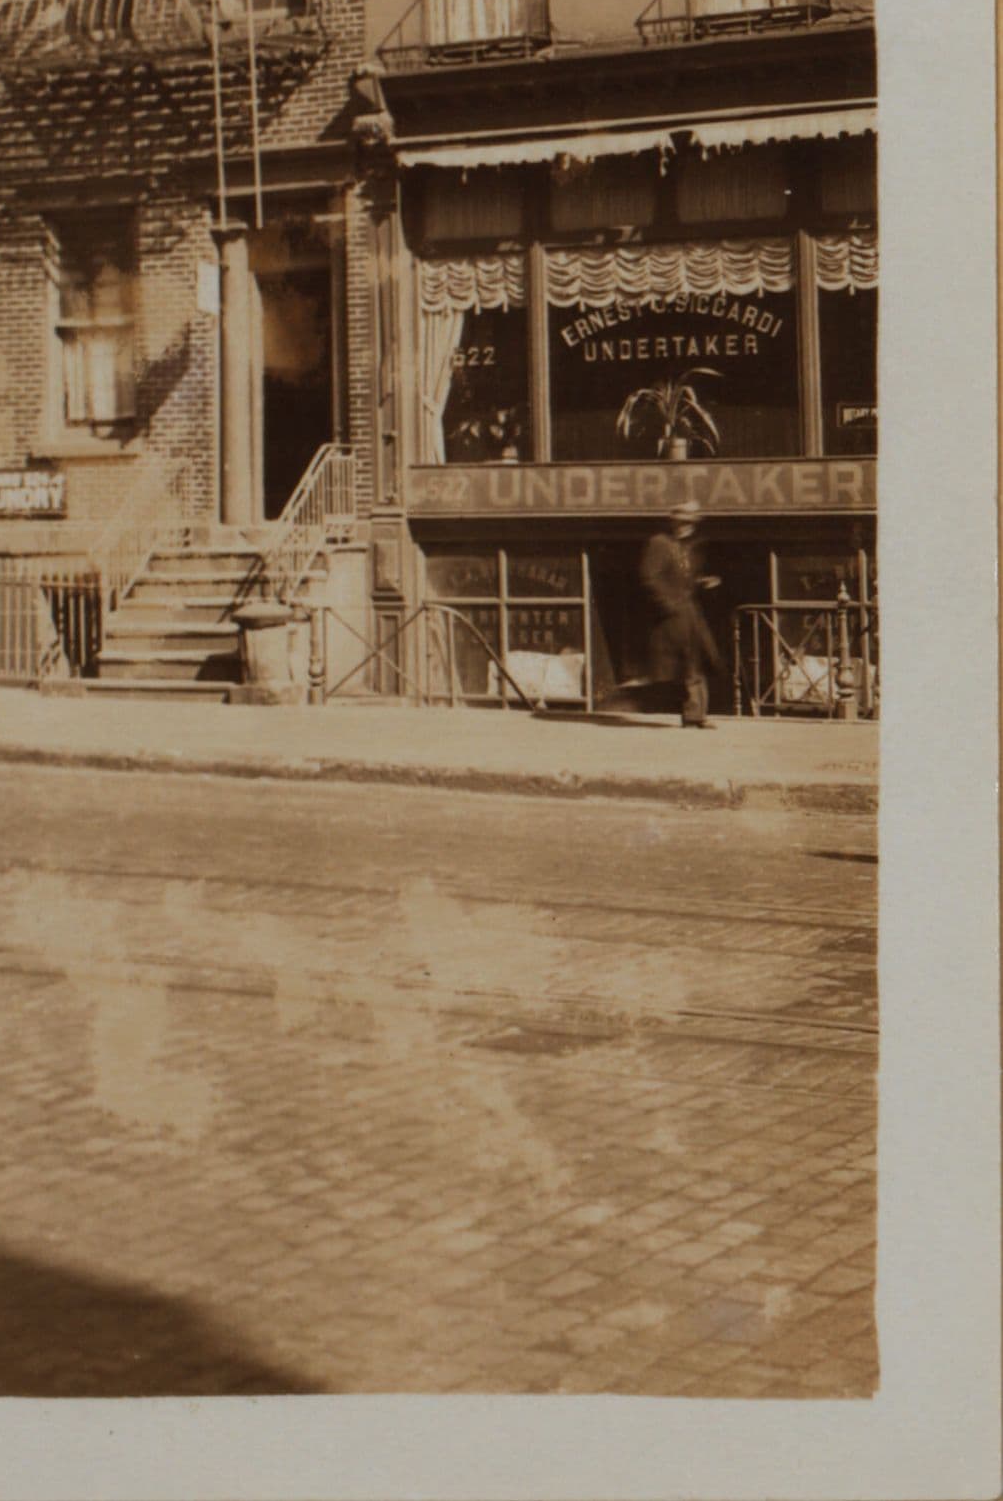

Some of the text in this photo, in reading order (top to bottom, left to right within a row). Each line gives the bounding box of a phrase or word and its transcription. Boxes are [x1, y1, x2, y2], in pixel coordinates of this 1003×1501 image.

[560, 297, 644, 347] ERNEST
[675, 292, 783, 337] SICCARDI
[585, 334, 759, 361] UNDERTAKER
[489, 461, 866, 509] UNDERTAKER
